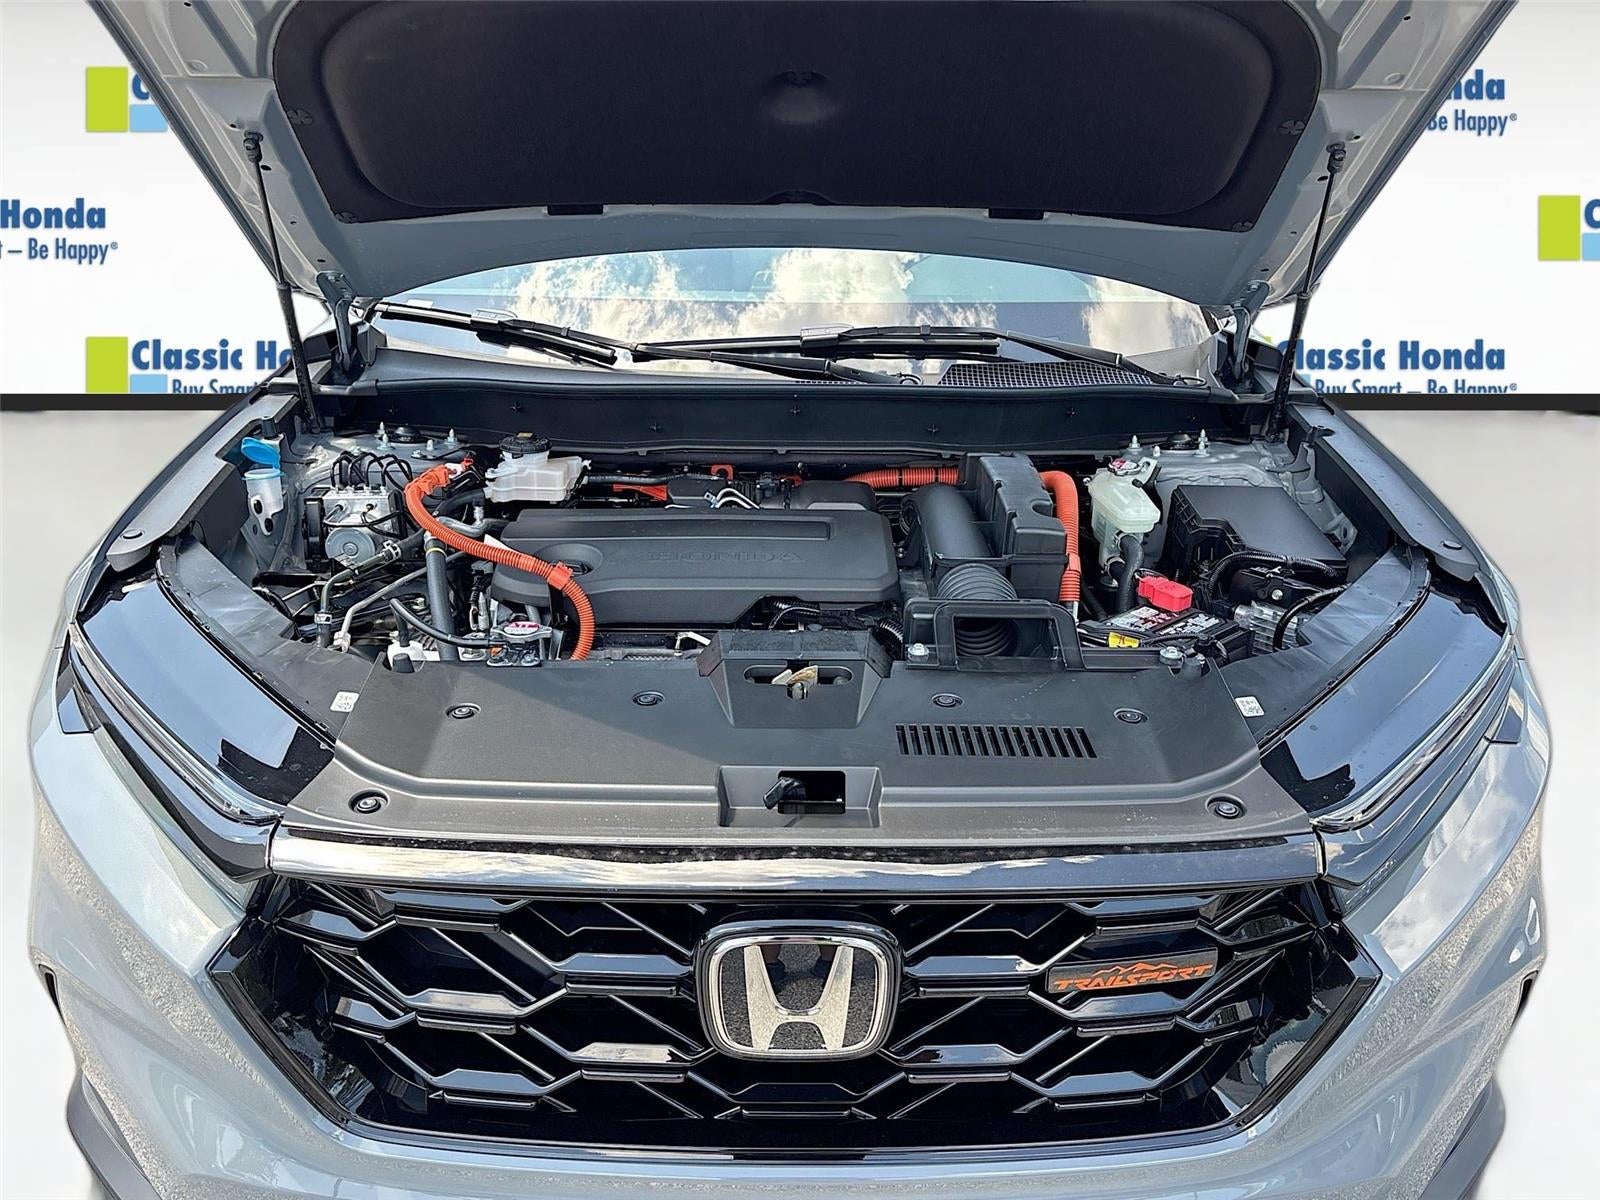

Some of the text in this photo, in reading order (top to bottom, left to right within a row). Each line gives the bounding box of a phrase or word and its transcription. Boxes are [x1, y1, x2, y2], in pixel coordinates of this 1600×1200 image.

[0, 198, 106, 229] Honda
[28, 237, 49, 260] Be
[131, 338, 243, 370] Classic
[1399, 338, 1505, 370] Honda
[1054, 963, 1214, 991] TRAILSPORT
